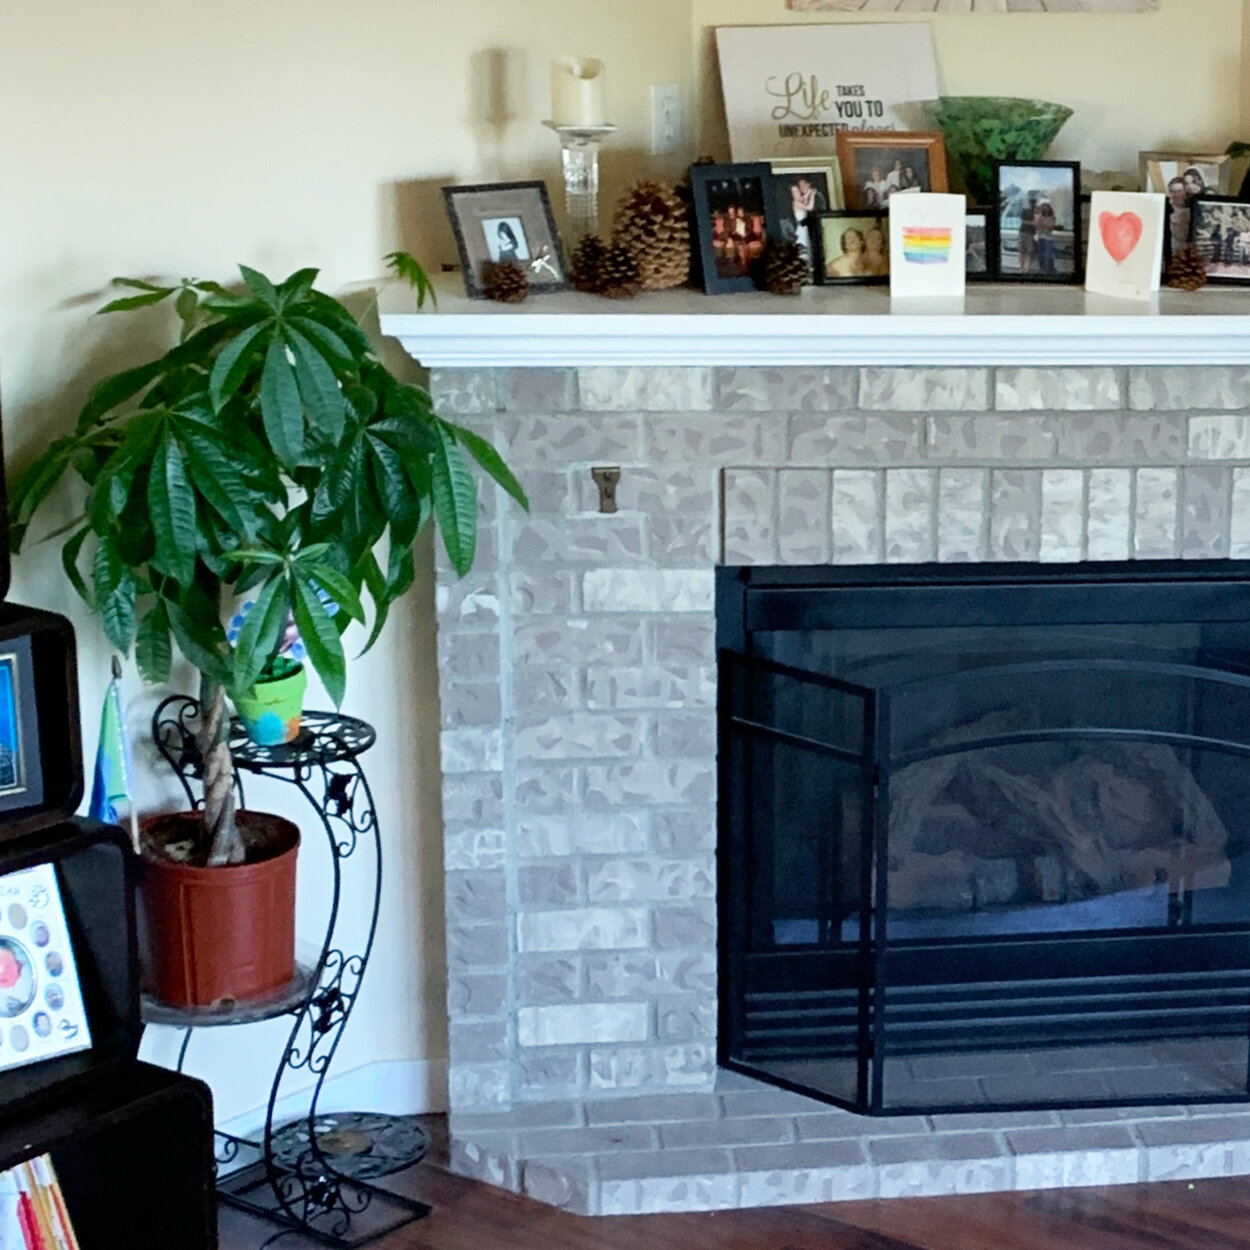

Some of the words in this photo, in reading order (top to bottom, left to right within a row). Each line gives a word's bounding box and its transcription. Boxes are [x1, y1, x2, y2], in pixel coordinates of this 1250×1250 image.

[766, 72, 830, 120] Life
[836, 85, 865, 97] TAKES
[834, 100, 863, 118] YOU
[865, 100, 884, 117] TO
